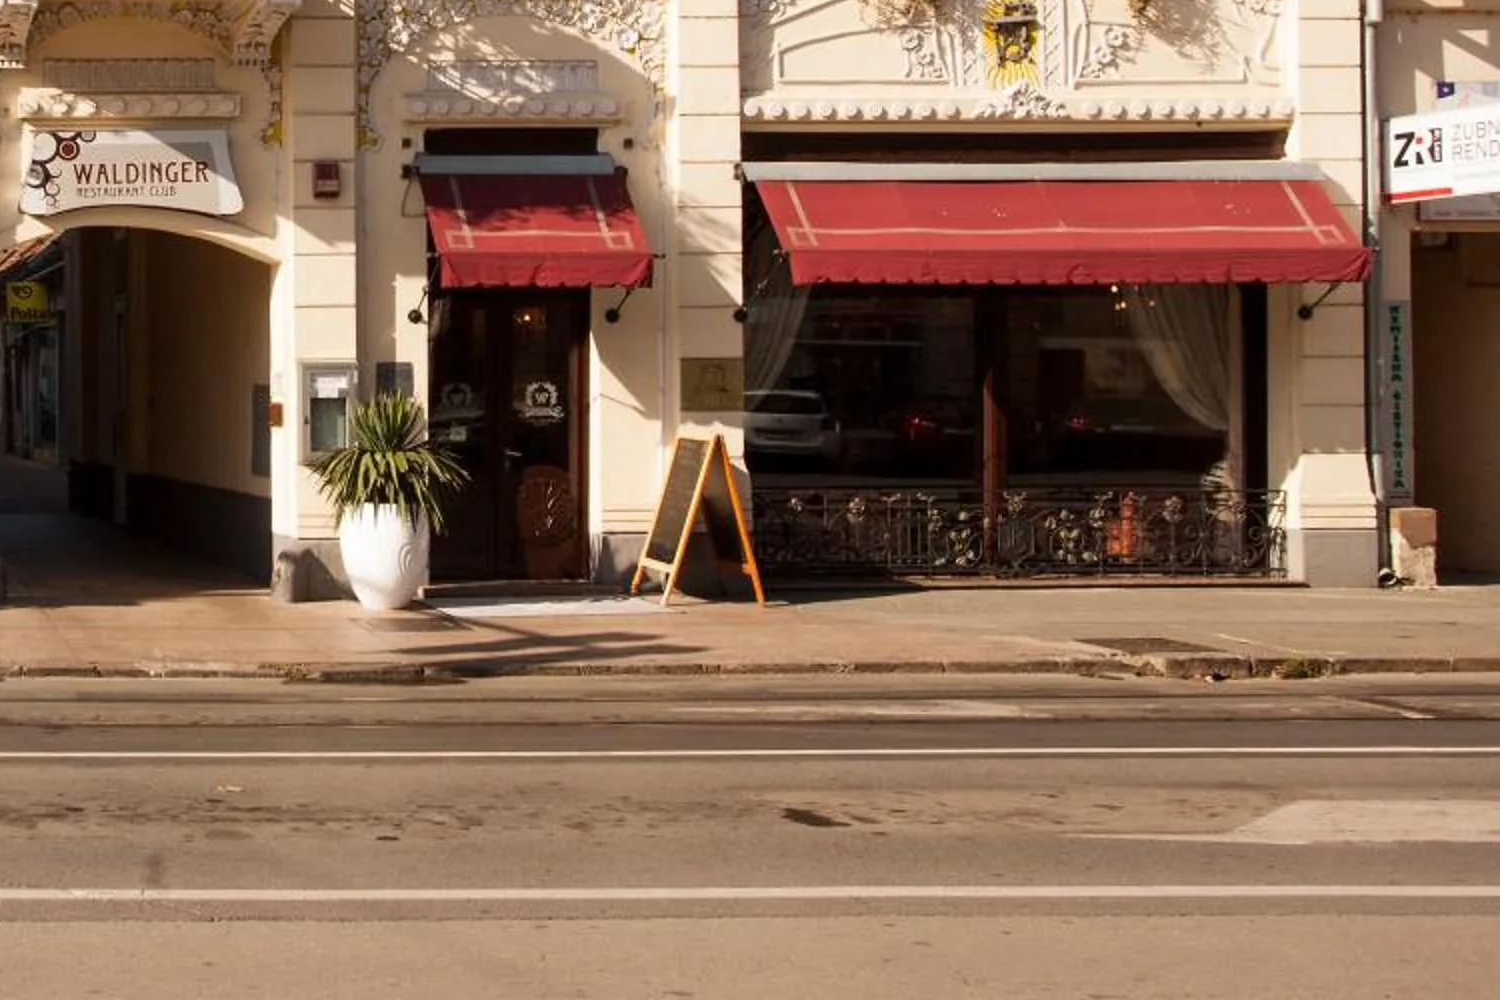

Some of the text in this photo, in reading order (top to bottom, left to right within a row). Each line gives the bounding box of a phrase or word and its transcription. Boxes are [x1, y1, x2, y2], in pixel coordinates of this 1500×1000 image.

[73, 161, 209, 185] WALDINGER
[76, 185, 177, 198] RESTAURANT CLUB
